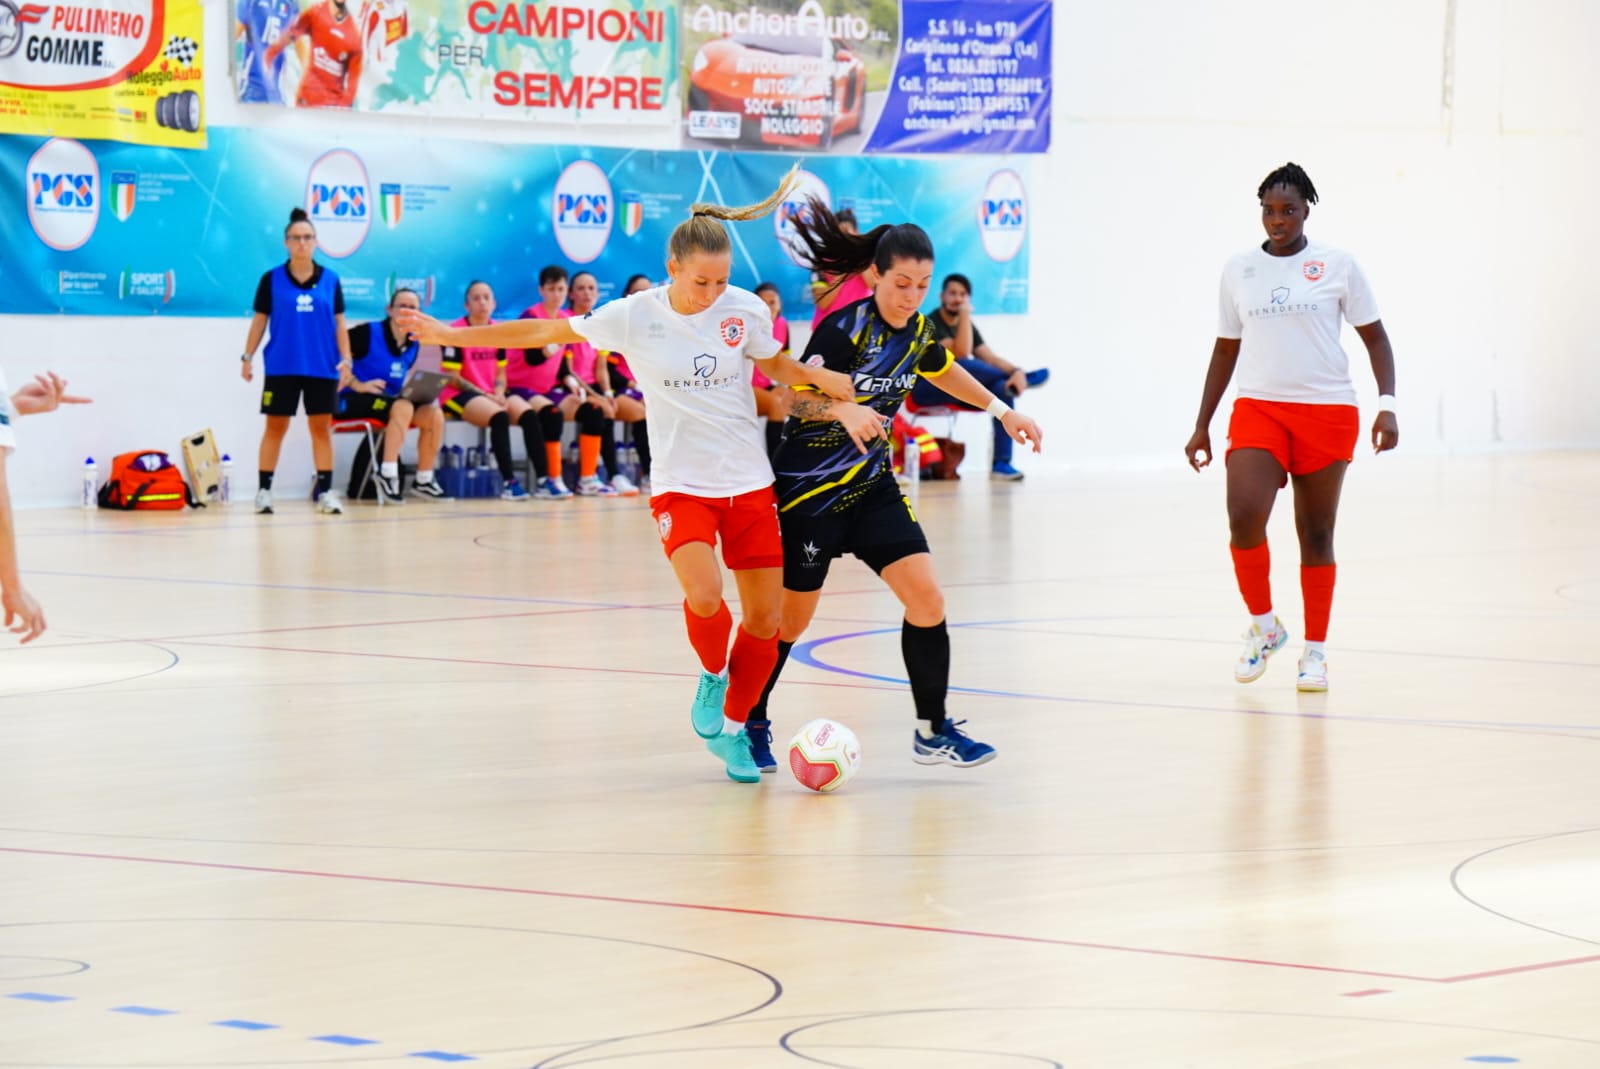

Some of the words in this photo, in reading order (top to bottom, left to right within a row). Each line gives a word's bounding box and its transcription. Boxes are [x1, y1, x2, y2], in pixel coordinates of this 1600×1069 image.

[52, 6, 144, 39] PULIMENO
[468, 0, 664, 42] CAMPIONI
[26, 35, 104, 66] GOMME
[438, 44, 485, 66] PER
[925, 55, 945, 74] Tel.
[493, 71, 663, 110] SEMPRE
[744, 98, 779, 115] SOCC.
[693, 114, 738, 129] LEASYS
[761, 117, 824, 135] NOLEGGIO
[32, 173, 93, 207] PGS
[312, 184, 366, 216] PGS
[558, 194, 607, 224] PGS
[982, 199, 1022, 225] PGS
[131, 273, 164, 286] SPORT
[1248, 303, 1318, 317] BENEDETTO
[870, 374, 917, 393] FRN
